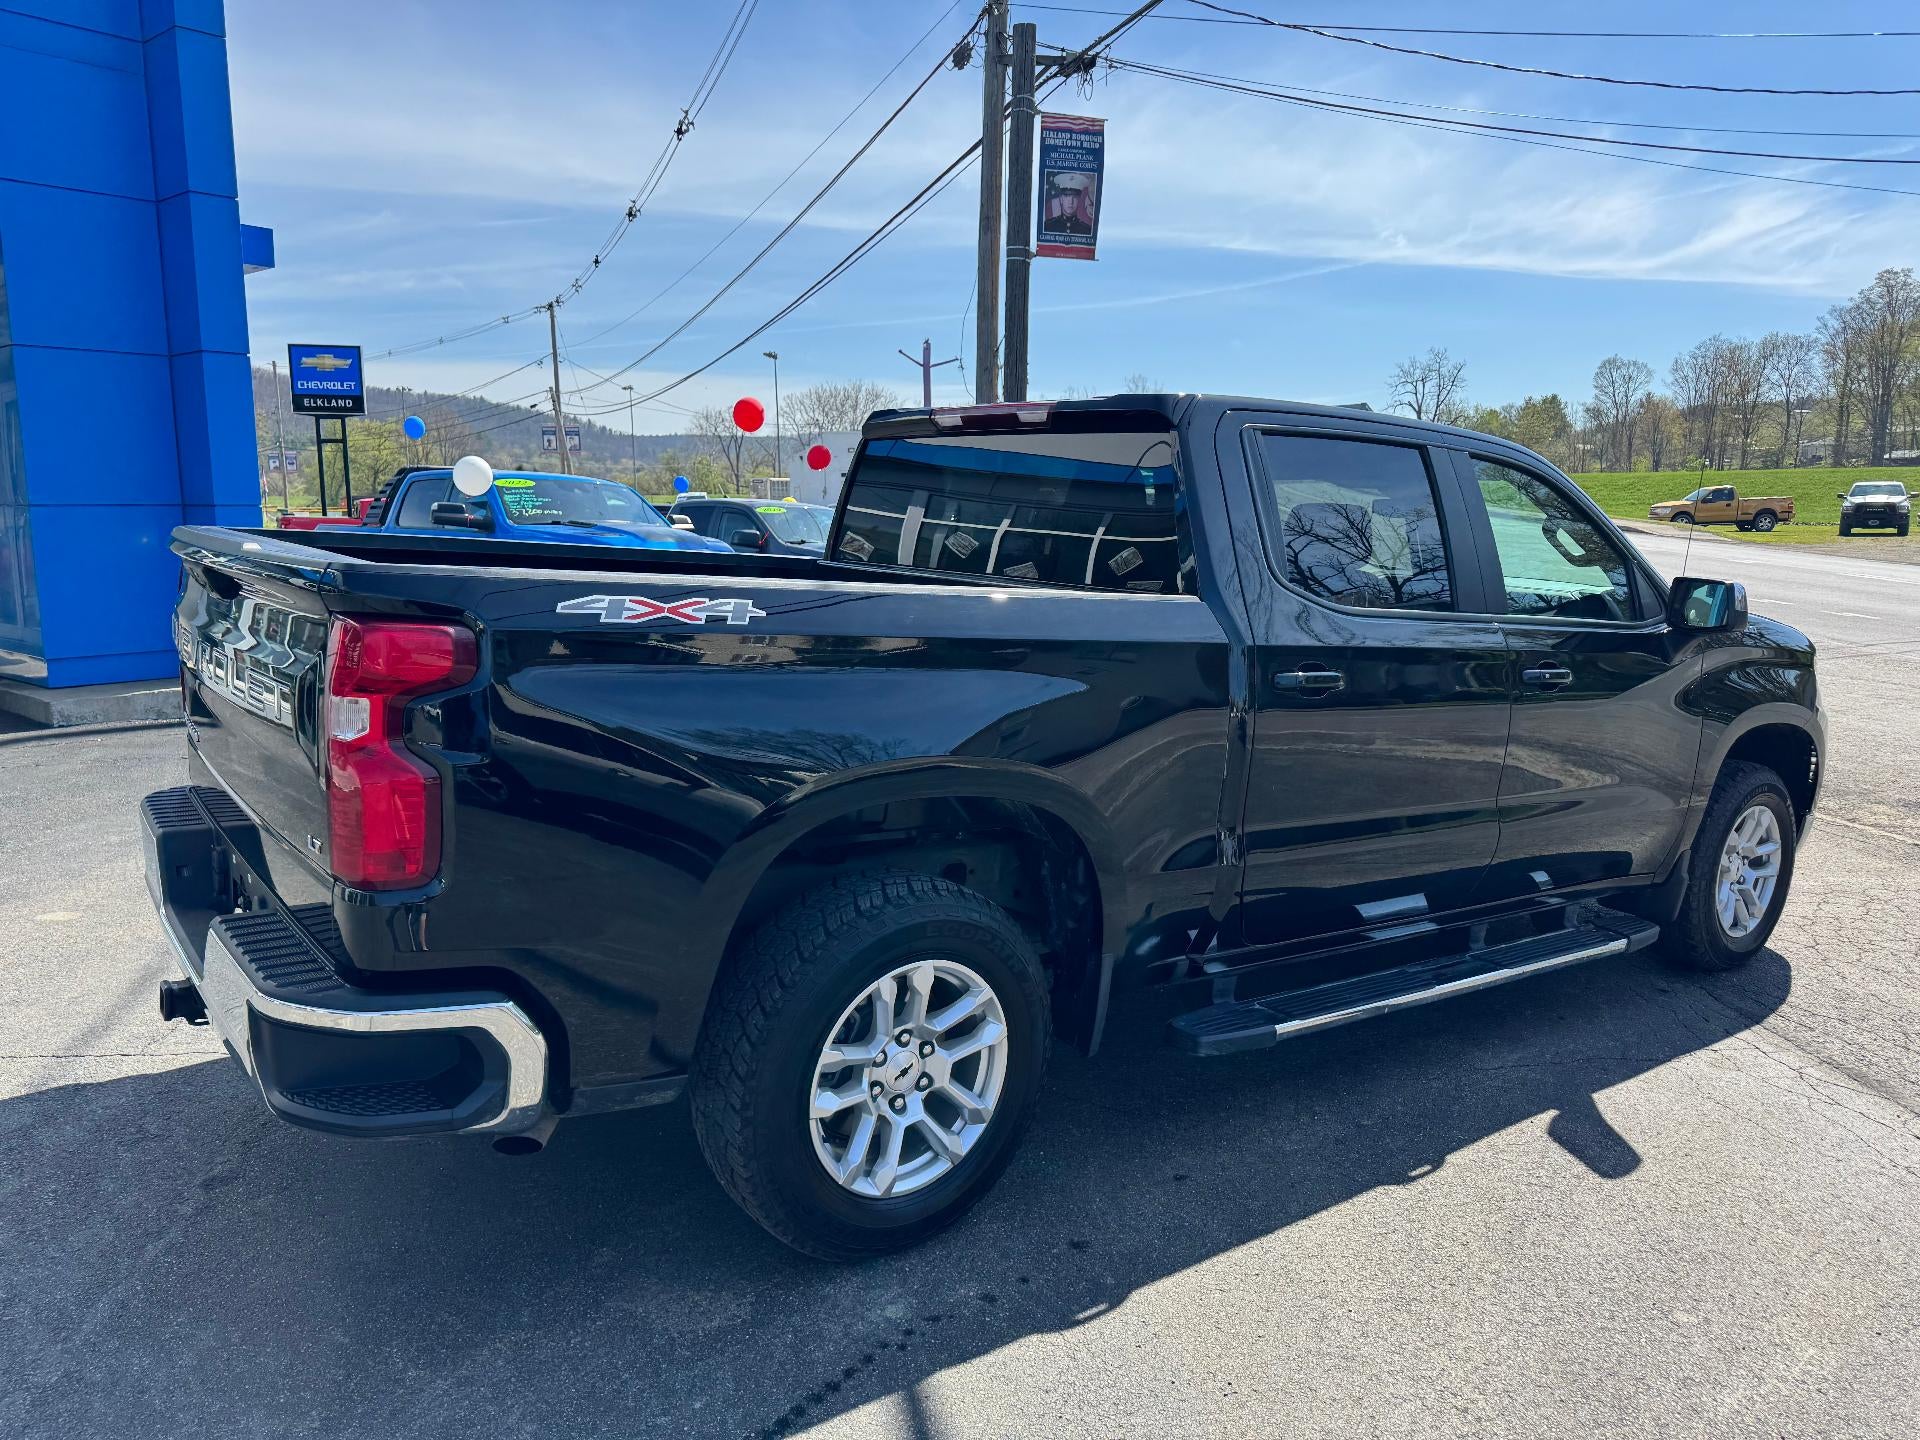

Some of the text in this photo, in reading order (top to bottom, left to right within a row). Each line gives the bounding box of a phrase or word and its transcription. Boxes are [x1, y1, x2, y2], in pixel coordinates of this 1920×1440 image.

[1043, 131, 1102, 142] ELKLAND BOROUGH
[1045, 138, 1100, 149] HOMETOWN HERO
[1050, 152, 1094, 161] MICHAEL PLANK
[297, 381, 356, 390] CHEVROLET
[303, 398, 353, 407] ELKLAND
[307, 834, 323, 855] LT
